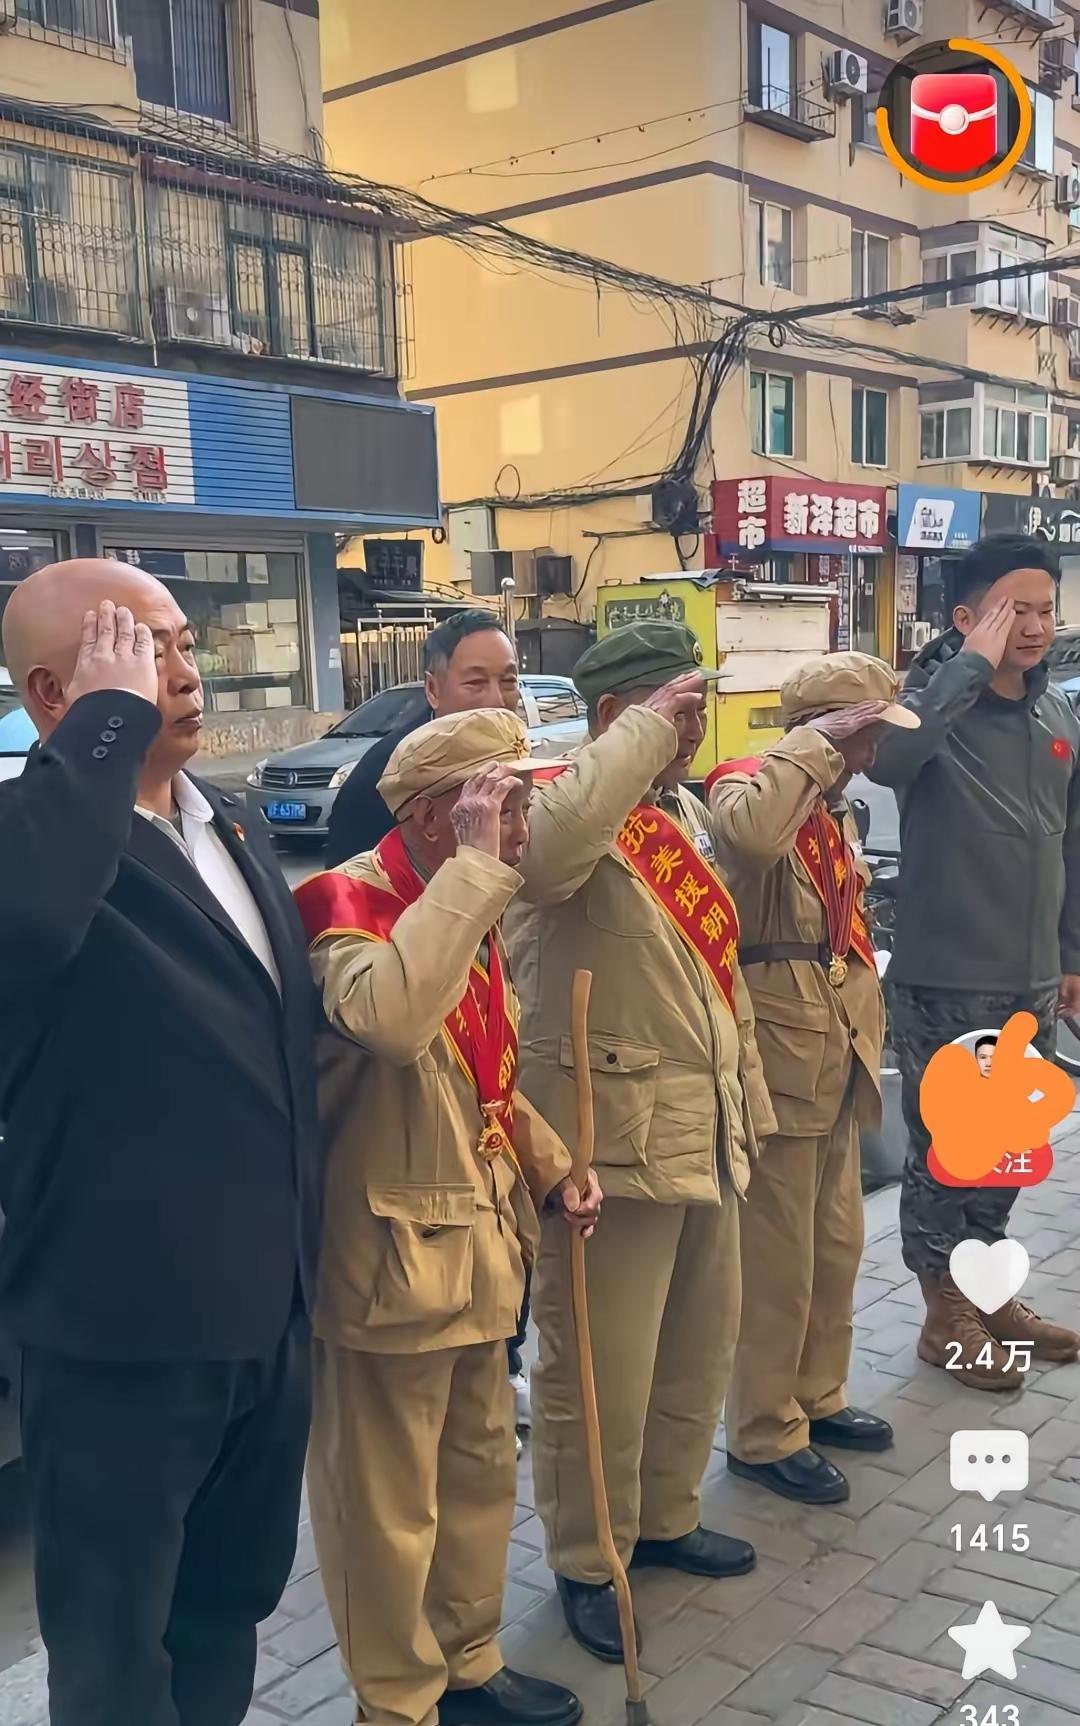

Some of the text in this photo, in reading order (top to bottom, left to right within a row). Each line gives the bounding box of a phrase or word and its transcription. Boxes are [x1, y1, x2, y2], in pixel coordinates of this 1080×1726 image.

[738, 480, 767, 549] 超市
[784, 493, 880, 538] 新泽超市
